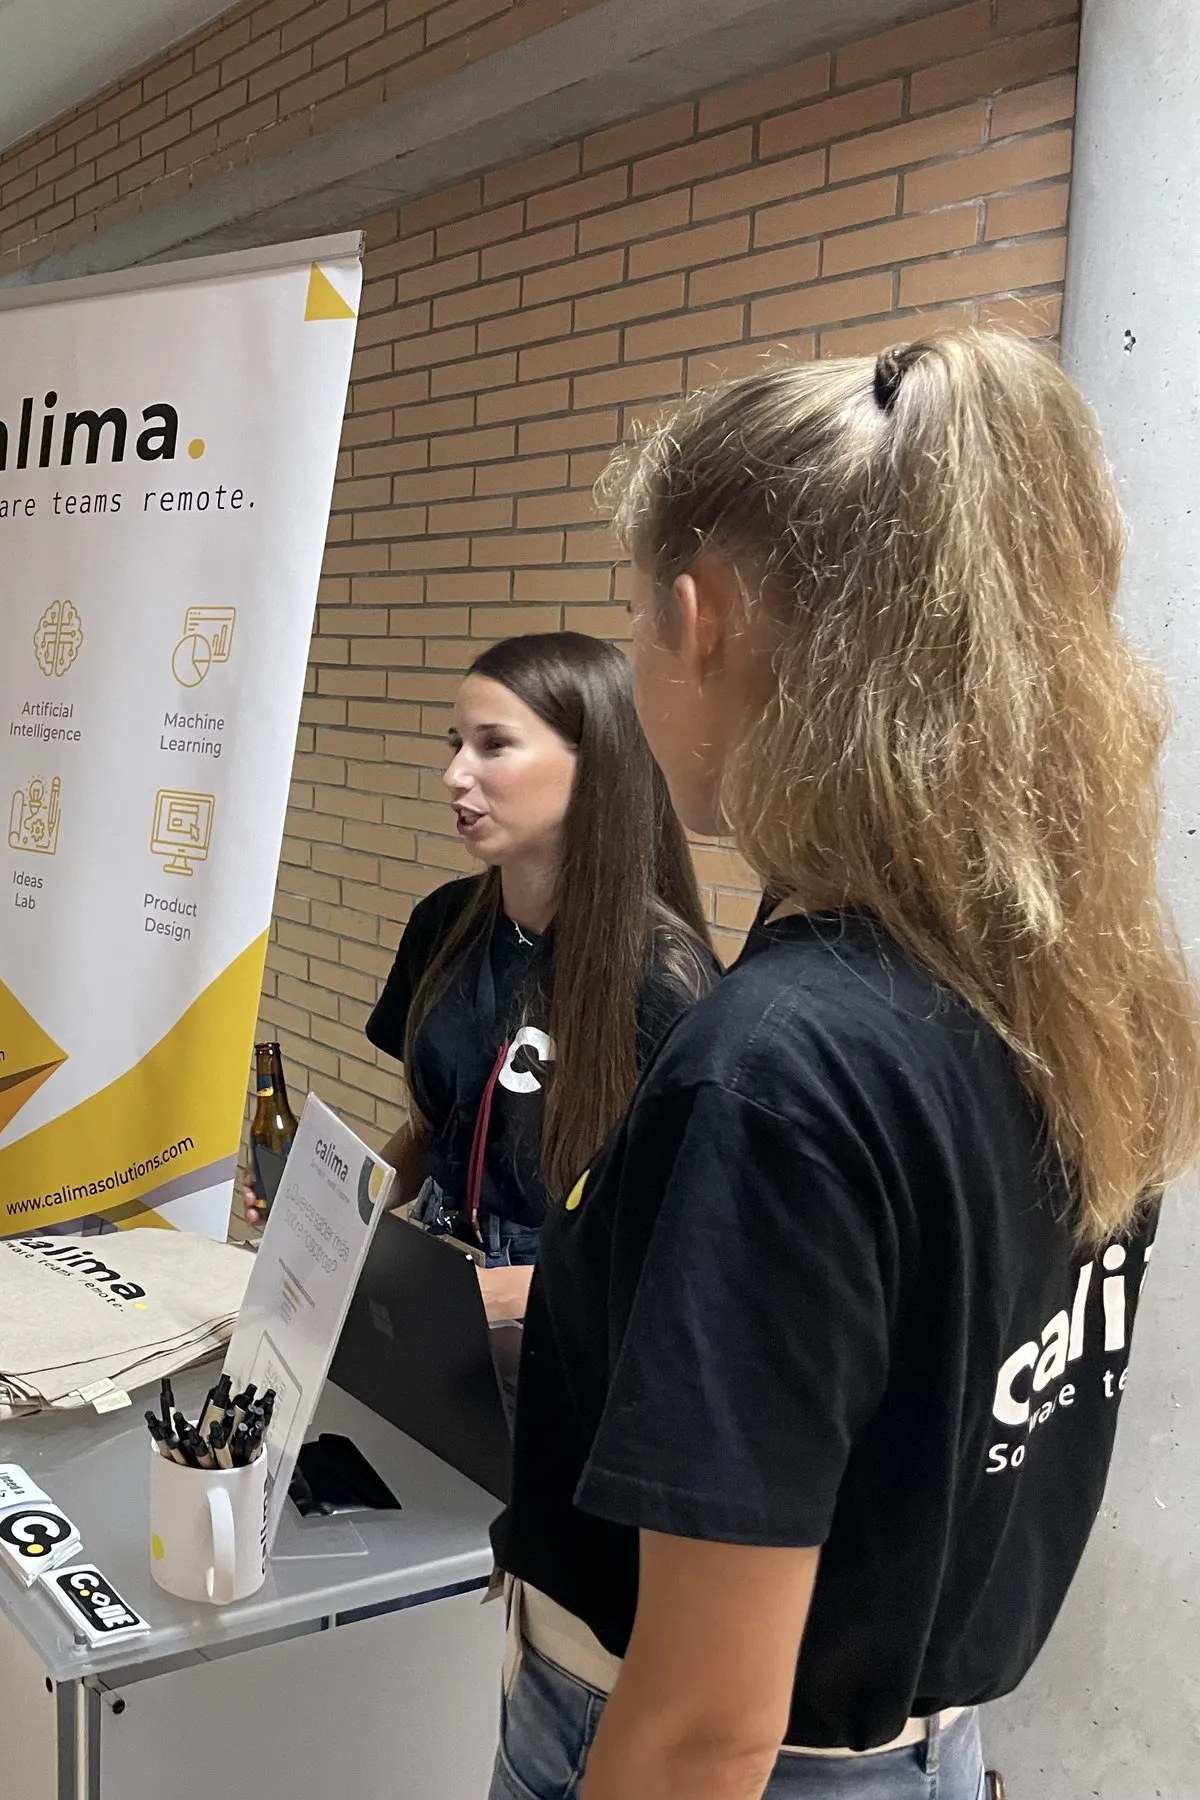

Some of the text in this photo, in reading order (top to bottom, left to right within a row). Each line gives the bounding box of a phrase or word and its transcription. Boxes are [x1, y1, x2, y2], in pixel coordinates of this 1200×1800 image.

[53, 492, 121, 514] teams
[144, 485, 254, 512] remote.
[21, 701, 74, 718] Artificial
[164, 712, 224, 730] Machine
[9, 722, 81, 742] Intelligence
[160, 735, 222, 758] Learning
[12, 871, 43, 888] Ideas
[14, 893, 36, 909] Lab
[144, 893, 197, 917] Product
[145, 917, 191, 941] Design
[5, 1137, 195, 1215] www.calimasolutions.com
[0, 1475, 23, 1490] need
